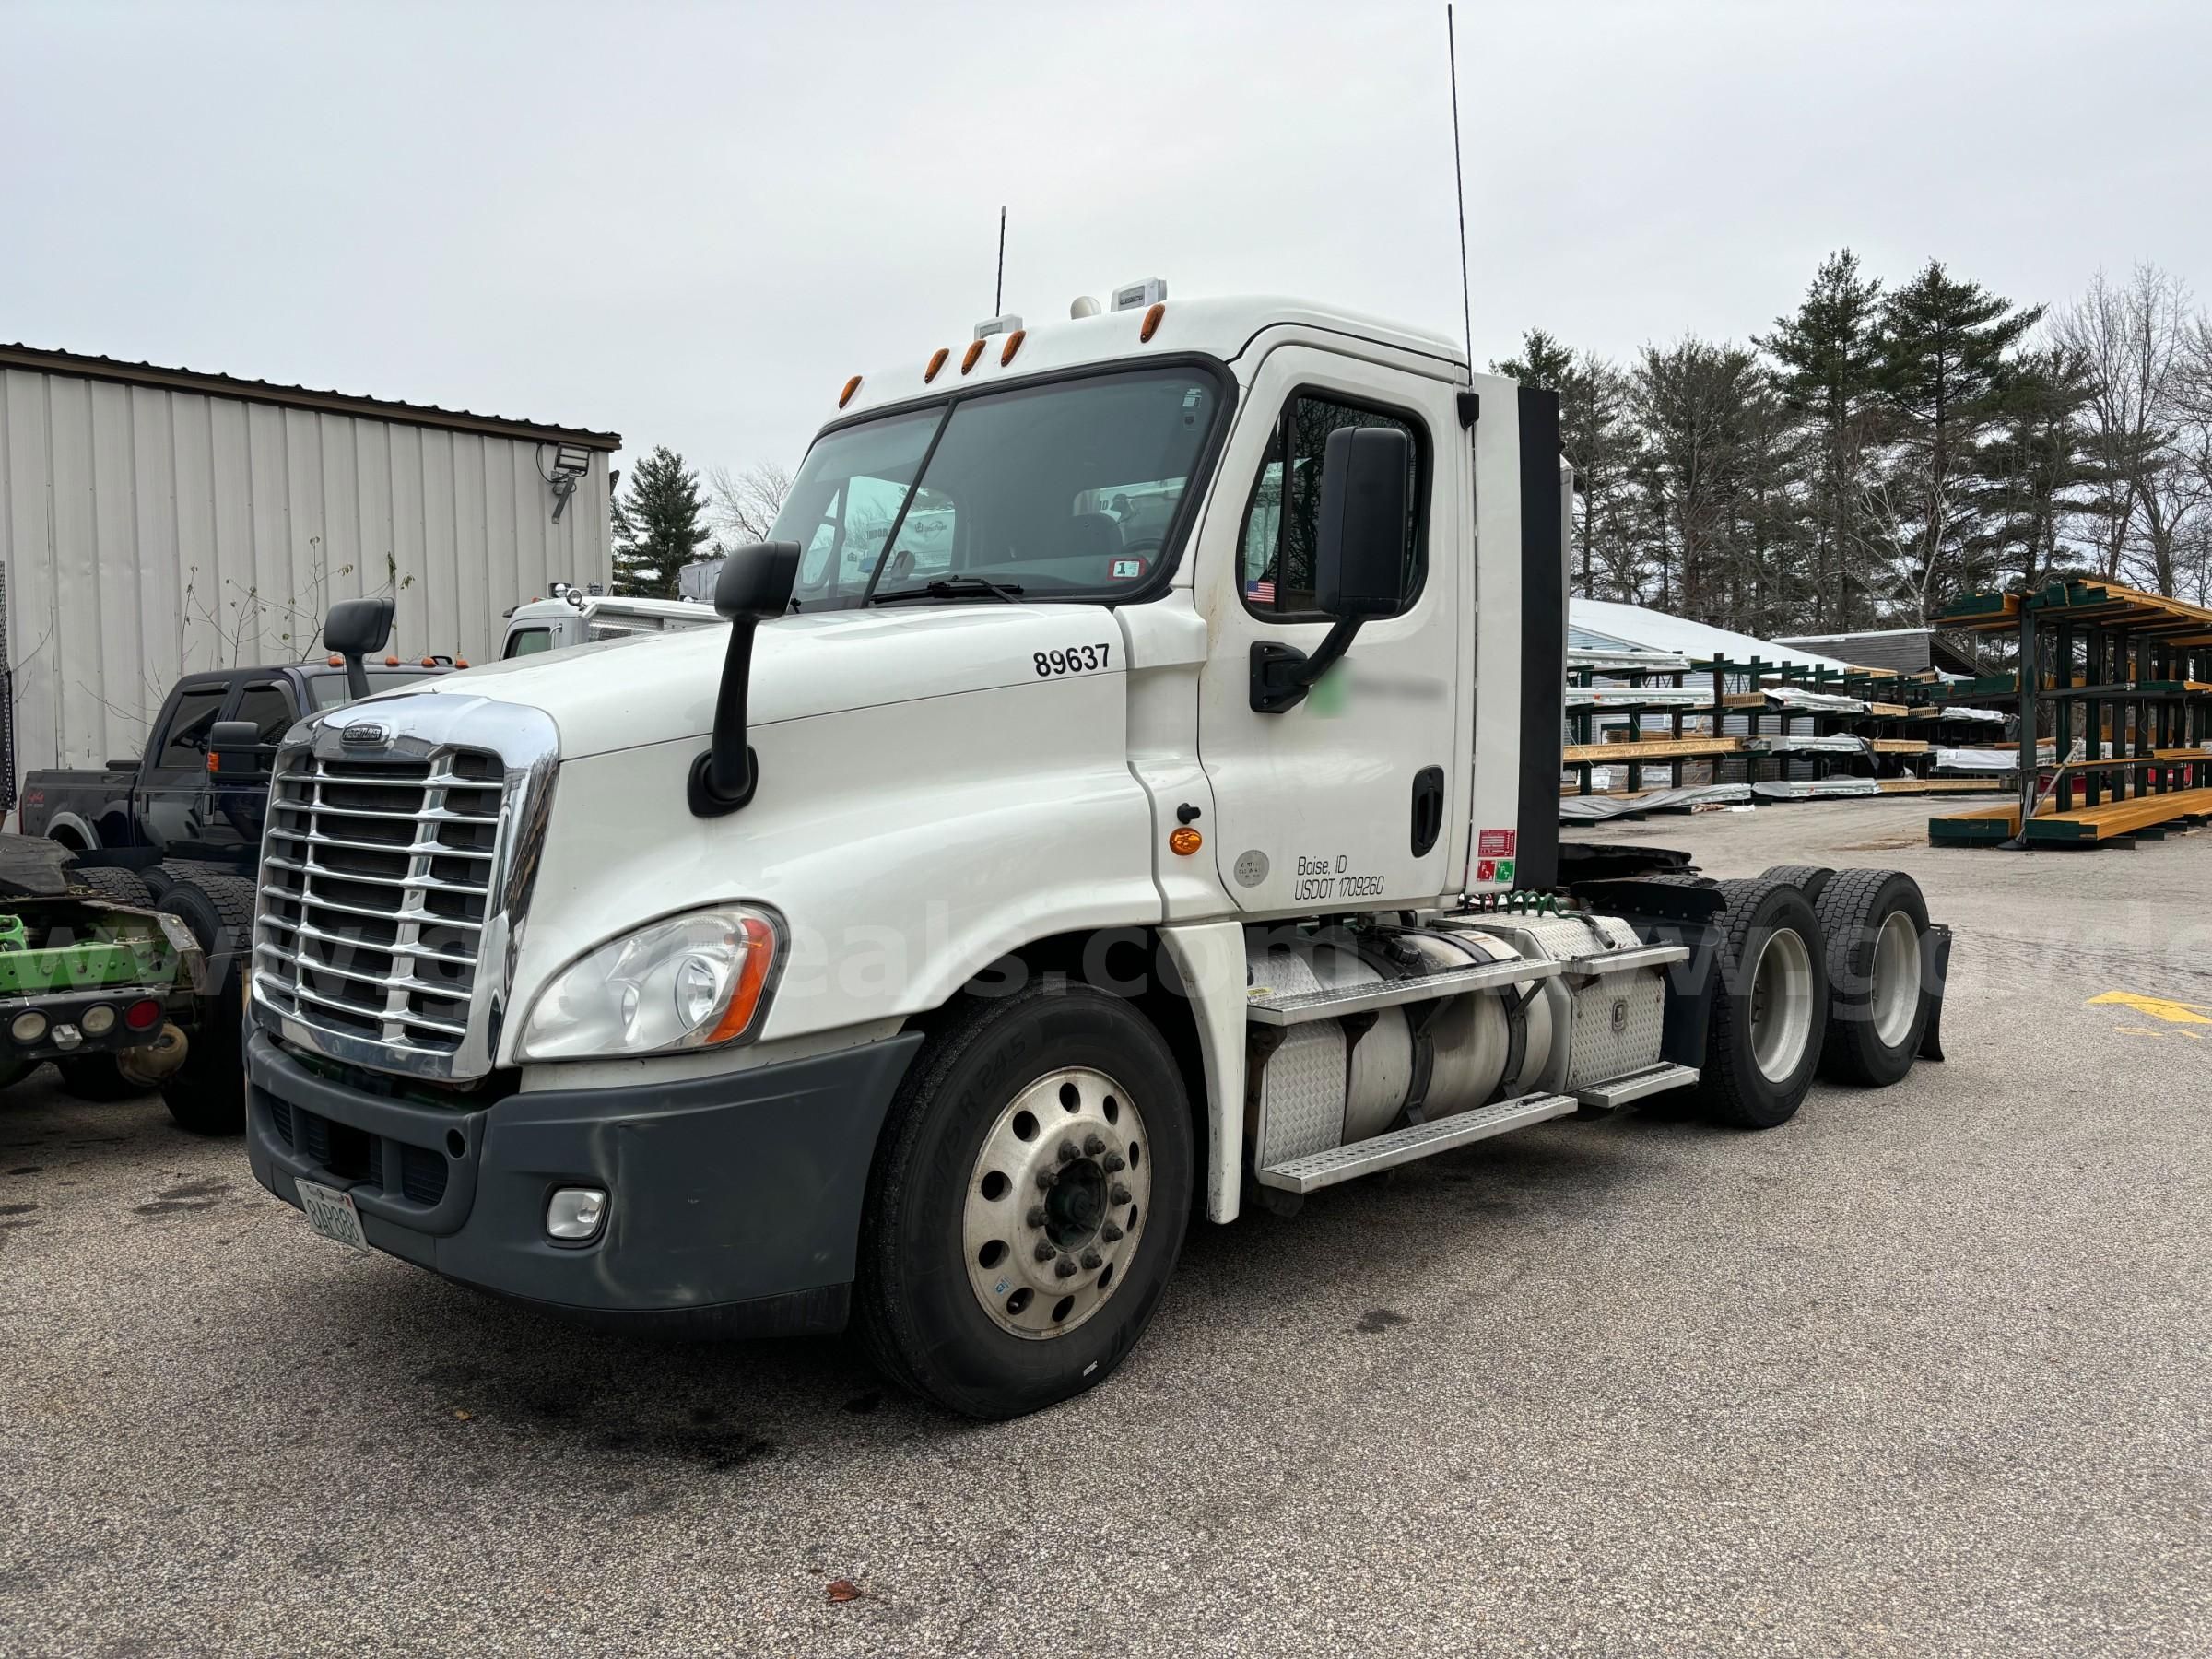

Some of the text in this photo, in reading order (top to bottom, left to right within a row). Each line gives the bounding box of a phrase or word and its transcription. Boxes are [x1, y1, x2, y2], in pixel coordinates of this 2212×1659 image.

[1033, 643, 1109, 677] 89637
[1297, 854, 1347, 876] Boise, ID
[1294, 876, 1384, 900] USDOT 1709260
